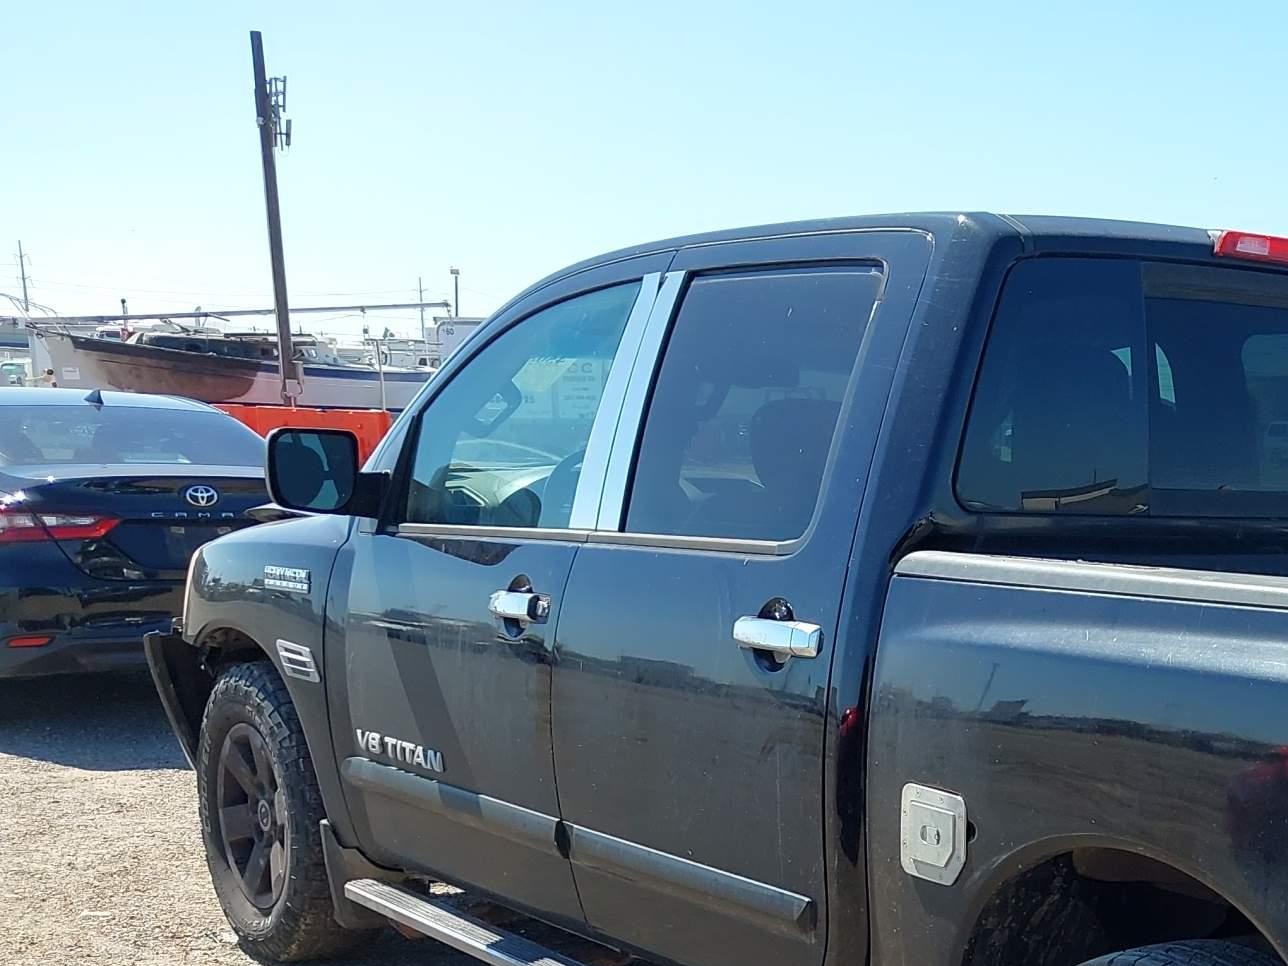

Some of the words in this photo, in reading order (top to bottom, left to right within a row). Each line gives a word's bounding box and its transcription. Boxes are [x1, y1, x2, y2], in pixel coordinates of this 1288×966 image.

[151, 511, 235, 519] CAMR
[356, 728, 381, 755] V8
[383, 735, 445, 773] TITAN
